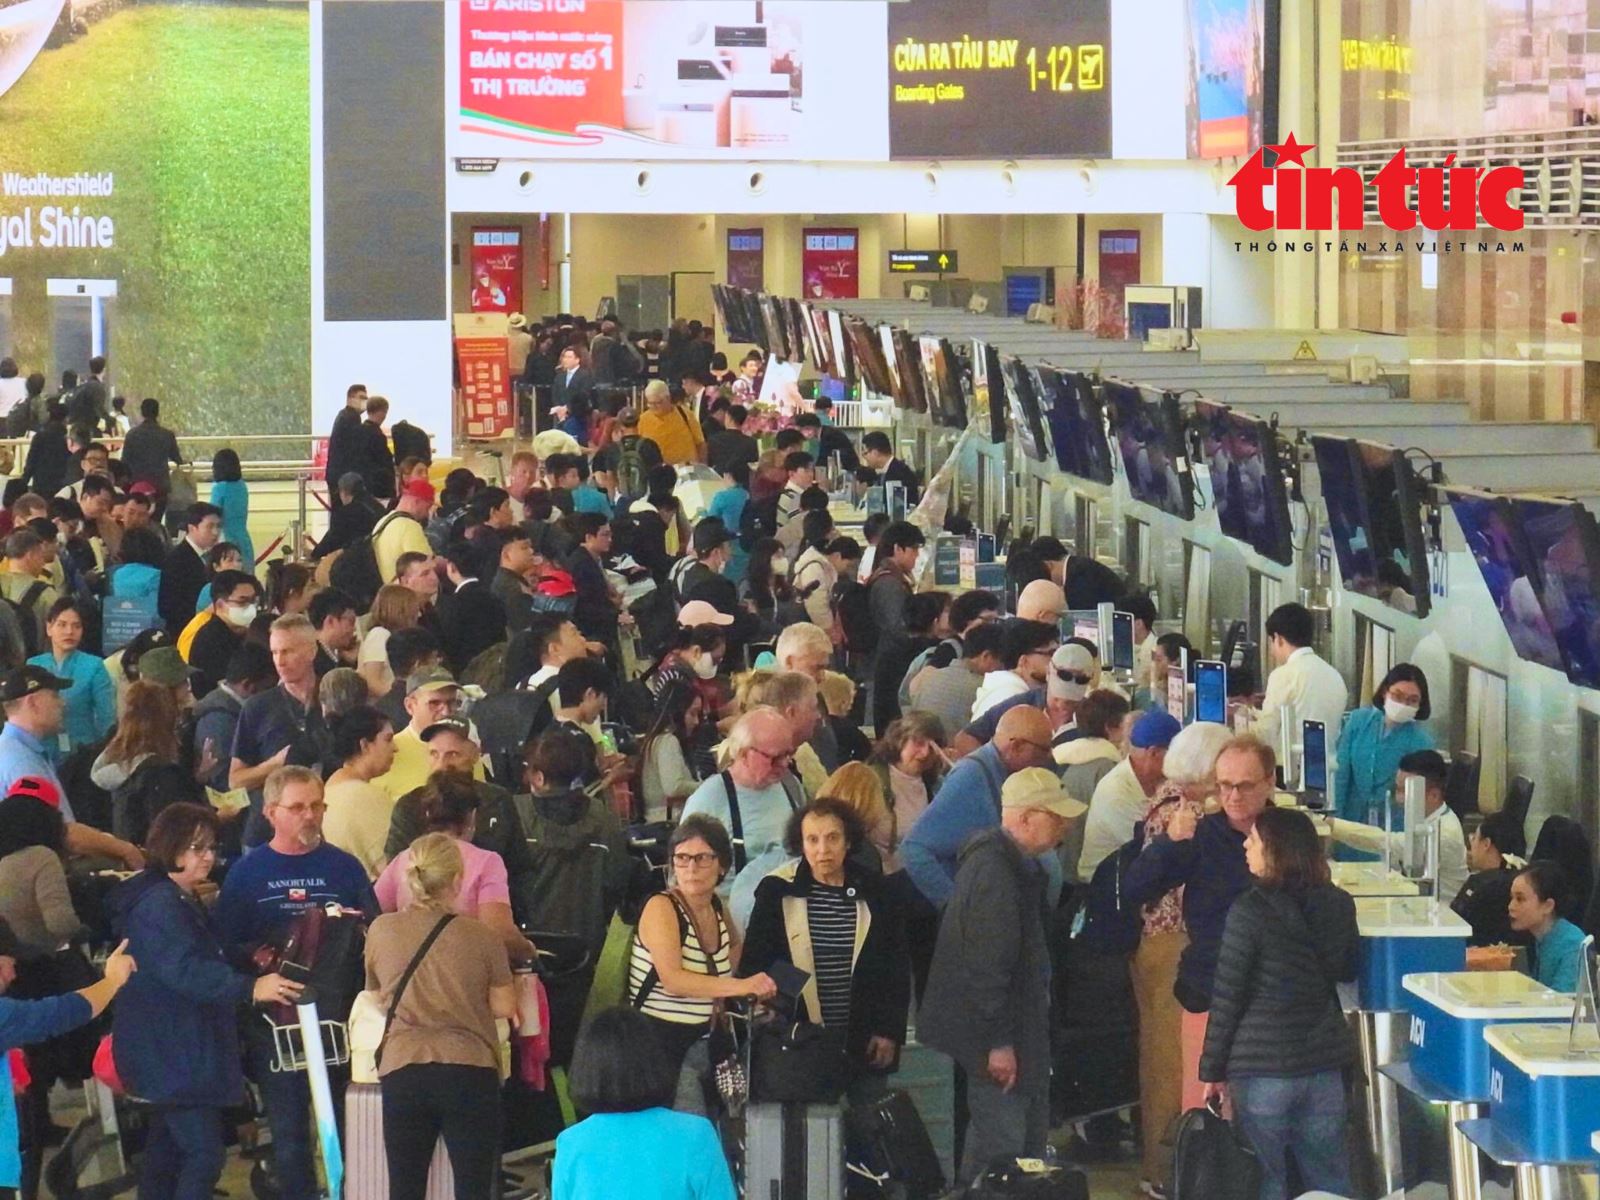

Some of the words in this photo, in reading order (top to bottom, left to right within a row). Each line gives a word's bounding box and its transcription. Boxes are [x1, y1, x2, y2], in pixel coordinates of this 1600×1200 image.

[470, 48, 510, 69] BÁN
[514, 52, 566, 73] CHẠY
[569, 48, 597, 70] SỐ
[599, 45, 613, 70] 1
[895, 37, 927, 71] CỬA
[929, 42, 951, 70] RA
[952, 34, 983, 69] TÀU
[988, 39, 1019, 69] BAY
[1026, 46, 1073, 92] 1-12
[470, 77, 502, 99] THỊ
[506, 75, 587, 97] TRƯỜNG
[895, 84, 935, 104] Boarding
[936, 83, 964, 100] Gates
[3, 171, 113, 197] Weathershield
[39, 205, 114, 248] Shine
